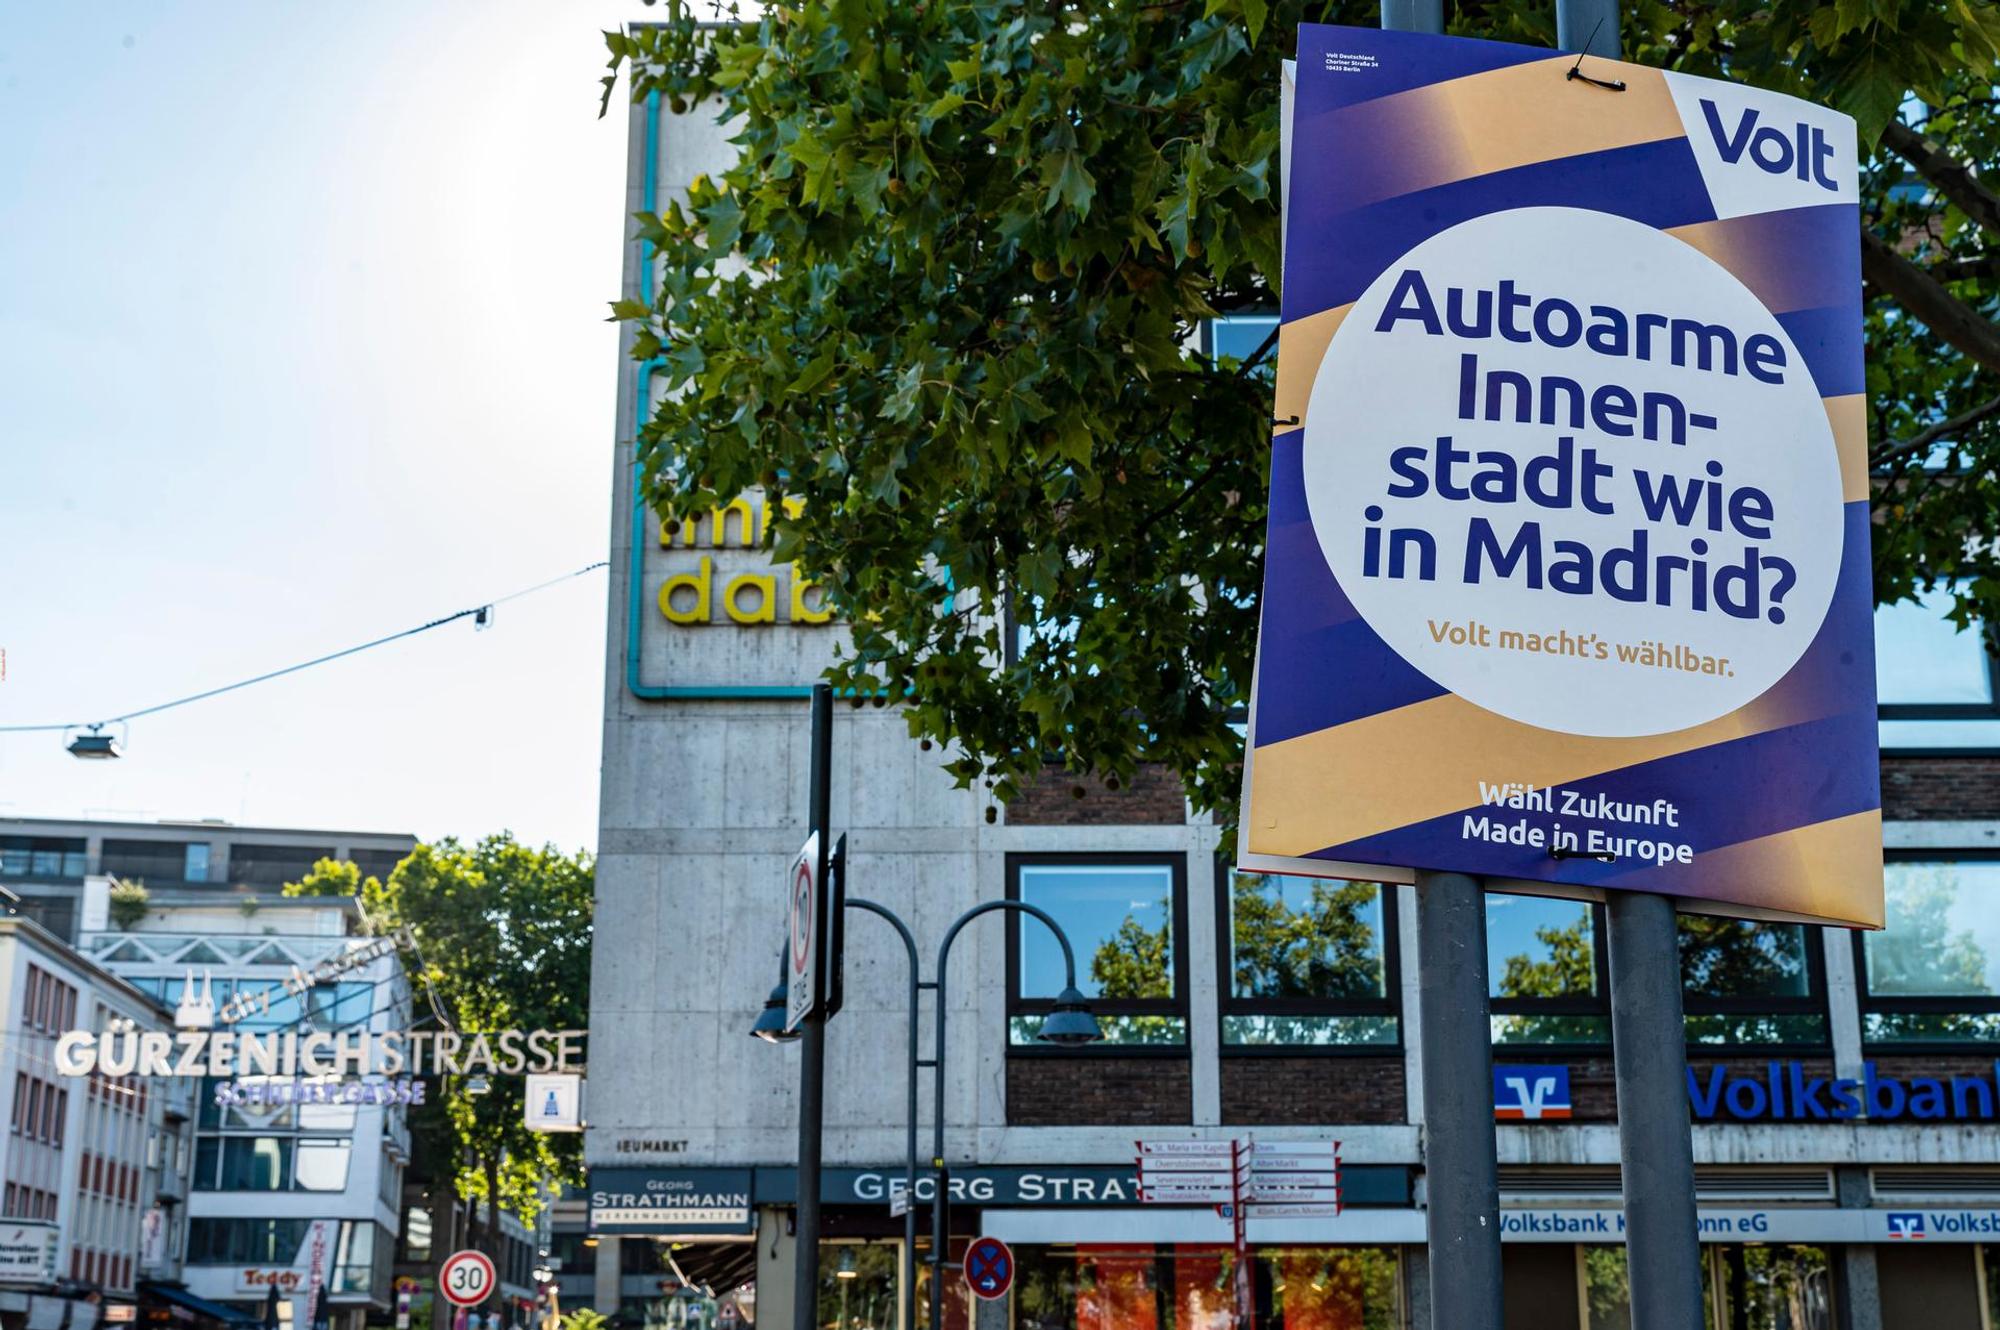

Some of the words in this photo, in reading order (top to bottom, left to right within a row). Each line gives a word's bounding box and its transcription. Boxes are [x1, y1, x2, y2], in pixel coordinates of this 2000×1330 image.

[1339, 53, 1375, 61] Deutschland
[1700, 97, 1839, 192] Volt
[1374, 269, 1788, 386] Autoarme
[1458, 353, 1719, 447] Innen-
[1386, 436, 1615, 515] stadt
[1633, 459, 1775, 540] wie
[1362, 504, 1437, 582] in
[1462, 516, 1797, 625] Madrid?
[1427, 619, 1491, 648] Volt
[1615, 640, 1735, 678] wählbar.
[1478, 780, 1554, 814] Wähl
[1559, 788, 1680, 828] Zukunft
[1461, 814, 1545, 848] Made
[1552, 822, 1579, 852] in
[1586, 828, 1694, 867] Europe
[220, 991, 270, 1025] city
[54, 1017, 587, 1077] GÜRZENICHSTRASSE
[1686, 1059, 2000, 1119] Volksban
[591, 1191, 749, 1208] STRATHMANN
[646, 1179, 695, 1191] GEORG
[853, 1173, 994, 1201] GEORG
[595, 1212, 742, 1221] HERRENAUSSTATTER
[1500, 1213, 1608, 1233] Volksbank
[1738, 1214, 1768, 1233] eG
[244, 1270, 302, 1291] Teddy
[452, 1267, 483, 1290] 30
